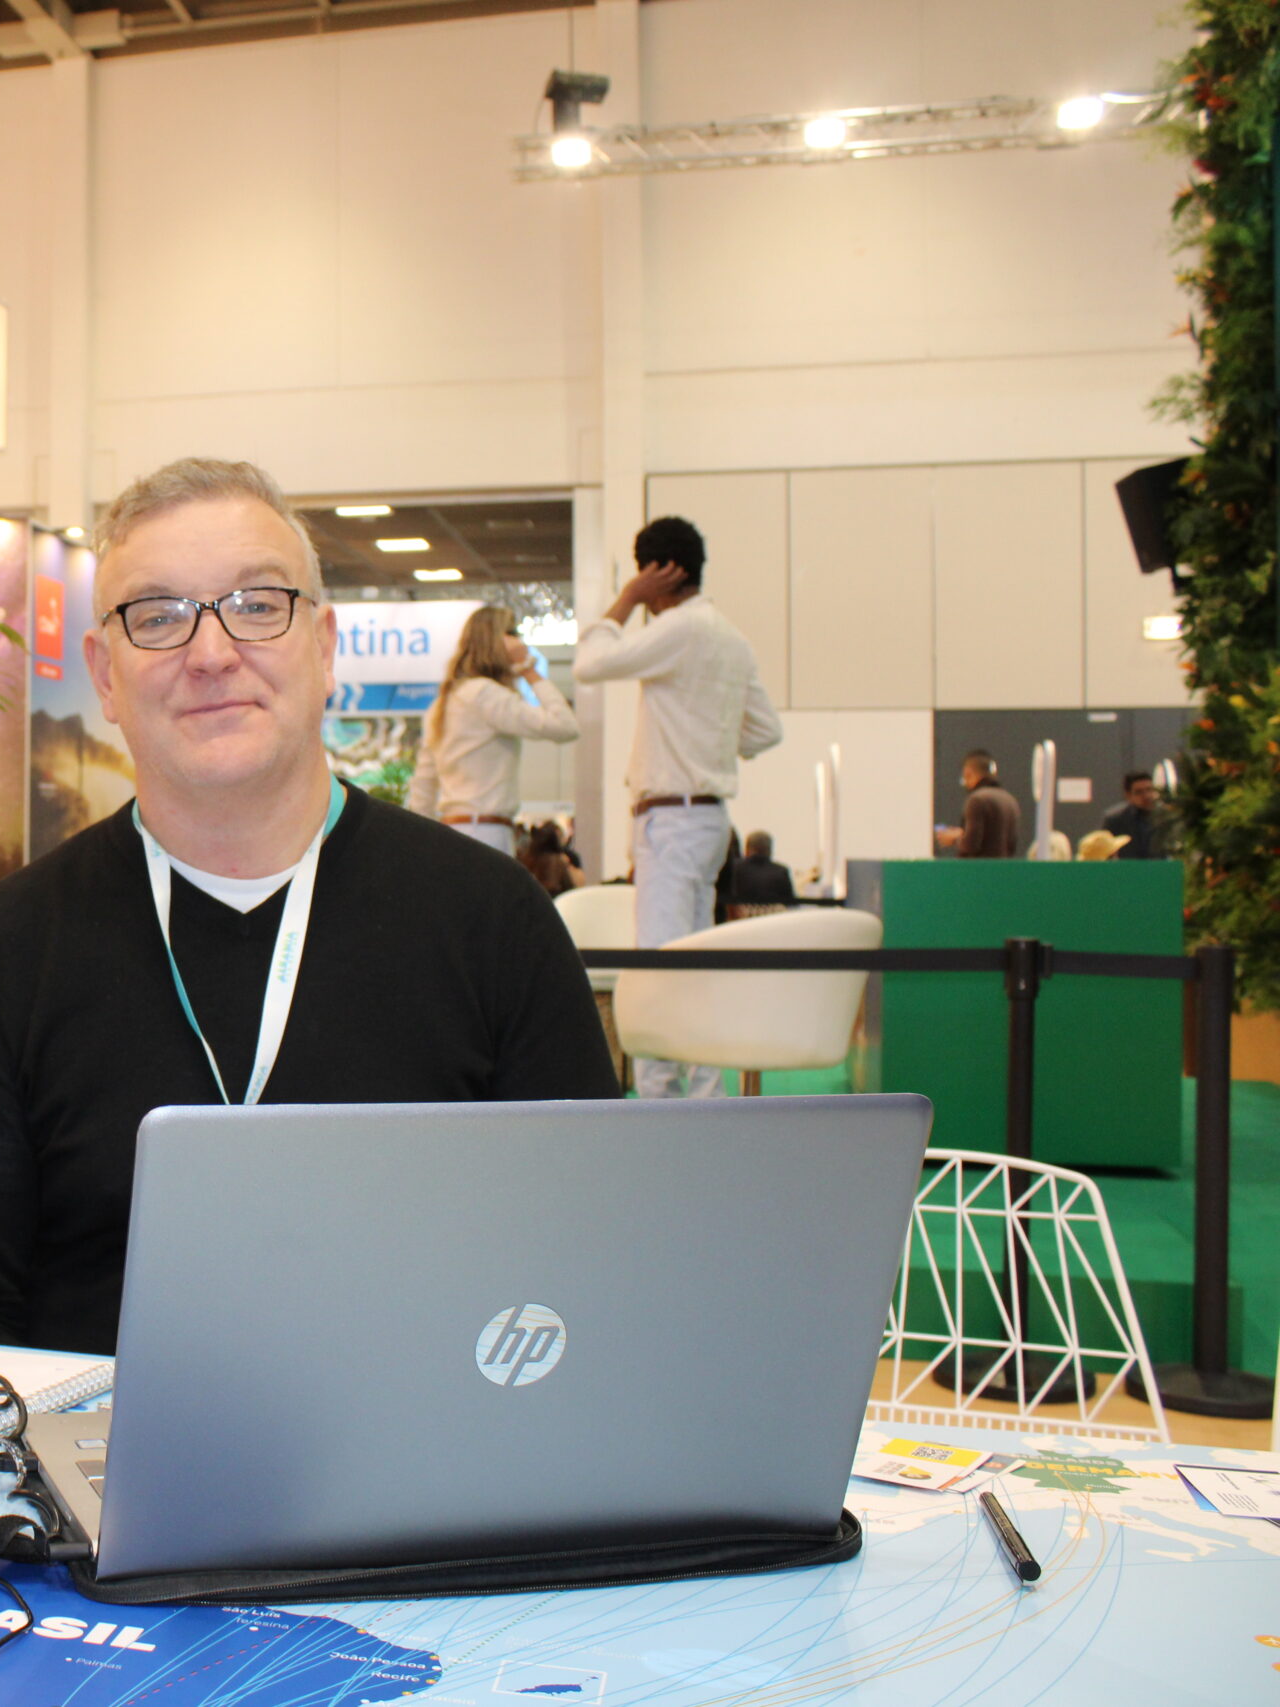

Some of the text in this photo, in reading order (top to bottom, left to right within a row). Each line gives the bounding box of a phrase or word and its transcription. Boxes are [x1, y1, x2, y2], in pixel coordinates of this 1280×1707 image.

[478, 1303, 564, 1386] hp
[236, 1617, 290, 1630] Teresina
[75, 1656, 122, 1670] Palmas
[371, 1656, 426, 1669] Pessoa
[371, 1670, 421, 1682] Recife
